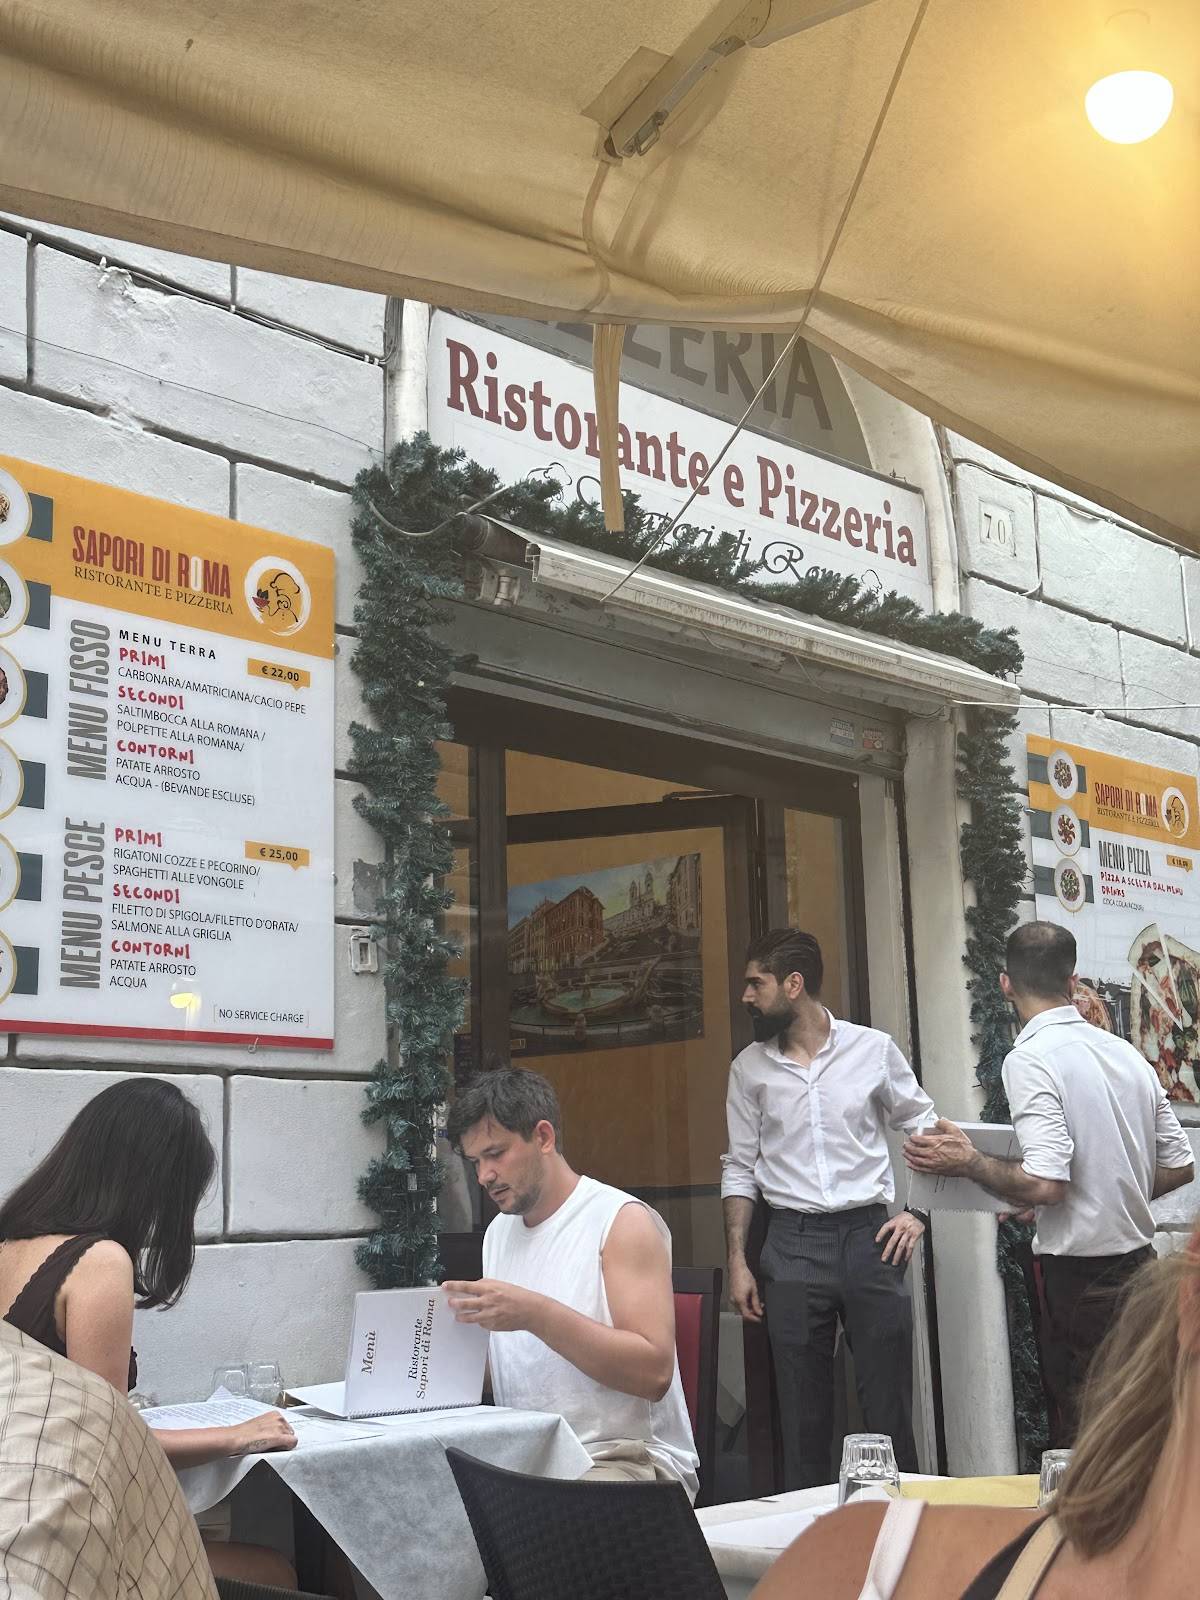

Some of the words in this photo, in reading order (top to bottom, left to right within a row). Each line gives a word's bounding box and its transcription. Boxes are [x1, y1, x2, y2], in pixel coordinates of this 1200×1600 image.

[446, 337, 710, 495] Ristorante
[723, 464, 745, 508] e
[757, 455, 917, 567] Pizzeria
[984, 512, 1006, 544] 70
[72, 525, 144, 578] SAPORI
[152, 546, 171, 583] DI
[177, 552, 231, 599] ROMA
[74, 566, 162, 597] RISTORANTE
[165, 588, 172, 600] E
[176, 590, 233, 615] PIZZERIA
[69, 619, 111, 698] FISSO
[119, 629, 162, 647] MENU
[169, 641, 216, 660] TERRA
[119, 647, 166, 670] PRIMI
[261, 665, 268, 675] €
[271, 665, 300, 682] 22,00
[118, 685, 184, 710] SECONDI
[284, 702, 307, 715] PEPE
[117, 704, 187, 726] SALTIMBOCCA
[190, 718, 214, 732] ALLA
[217, 724, 259, 740] ROMANA
[117, 719, 168, 738] POLPETTE
[169, 730, 195, 743] ALLA
[197, 735, 245, 753] ROMANA/
[67, 702, 108, 780] MENU
[116, 739, 194, 764] CONTORNI
[116, 757, 151, 773] PATATE
[153, 764, 201, 781] ARROSTO
[115, 774, 152, 789] ACQUA
[161, 781, 210, 799] (BEVANDE
[212, 790, 256, 806] ESCLUSE)
[1094, 782, 1124, 810] SAPORI
[1125, 789, 1134, 812] DI
[115, 827, 162, 847] PRIMI
[62, 816, 106, 903] PESCE
[113, 847, 162, 863] RIGATONI
[164, 854, 197, 868] COZZE
[200, 859, 205, 869] E
[208, 860, 260, 876] PECORINO/
[259, 847, 266, 857] €
[269, 849, 298, 861] 25,00
[1099, 840, 1125, 871] MENU
[1127, 846, 1152, 877] PIZZA
[113, 864, 169, 881] SPAGHETTI
[171, 871, 195, 884] ALLE
[196, 874, 245, 890] VONGOLE
[1121, 876, 1127, 885] A
[113, 883, 180, 904] SECONDI
[111, 920, 163, 935] SALMONE
[164, 924, 190, 938] ALLA
[192, 928, 232, 942] GRIGLIA
[112, 903, 153, 917] FILETTO
[155, 907, 167, 918] DI
[169, 909, 254, 928] SPIGOLA/FILETTO
[255, 918, 299, 933] D'ORATA/
[60, 911, 103, 989] MENU
[111, 940, 190, 960] CONTORNI
[110, 958, 146, 972] PATATE
[148, 962, 197, 976] ARROSTO
[109, 975, 147, 989] ACQUA
[219, 1008, 233, 1019] NO
[234, 1010, 269, 1021] SERVICE
[269, 1012, 304, 1023] CHARGE
[423, 1299, 436, 1336] Roma
[408, 1318, 423, 1380] Ristorante
[421, 1340, 431, 1353] di
[416, 1355, 429, 1399] Sapori
